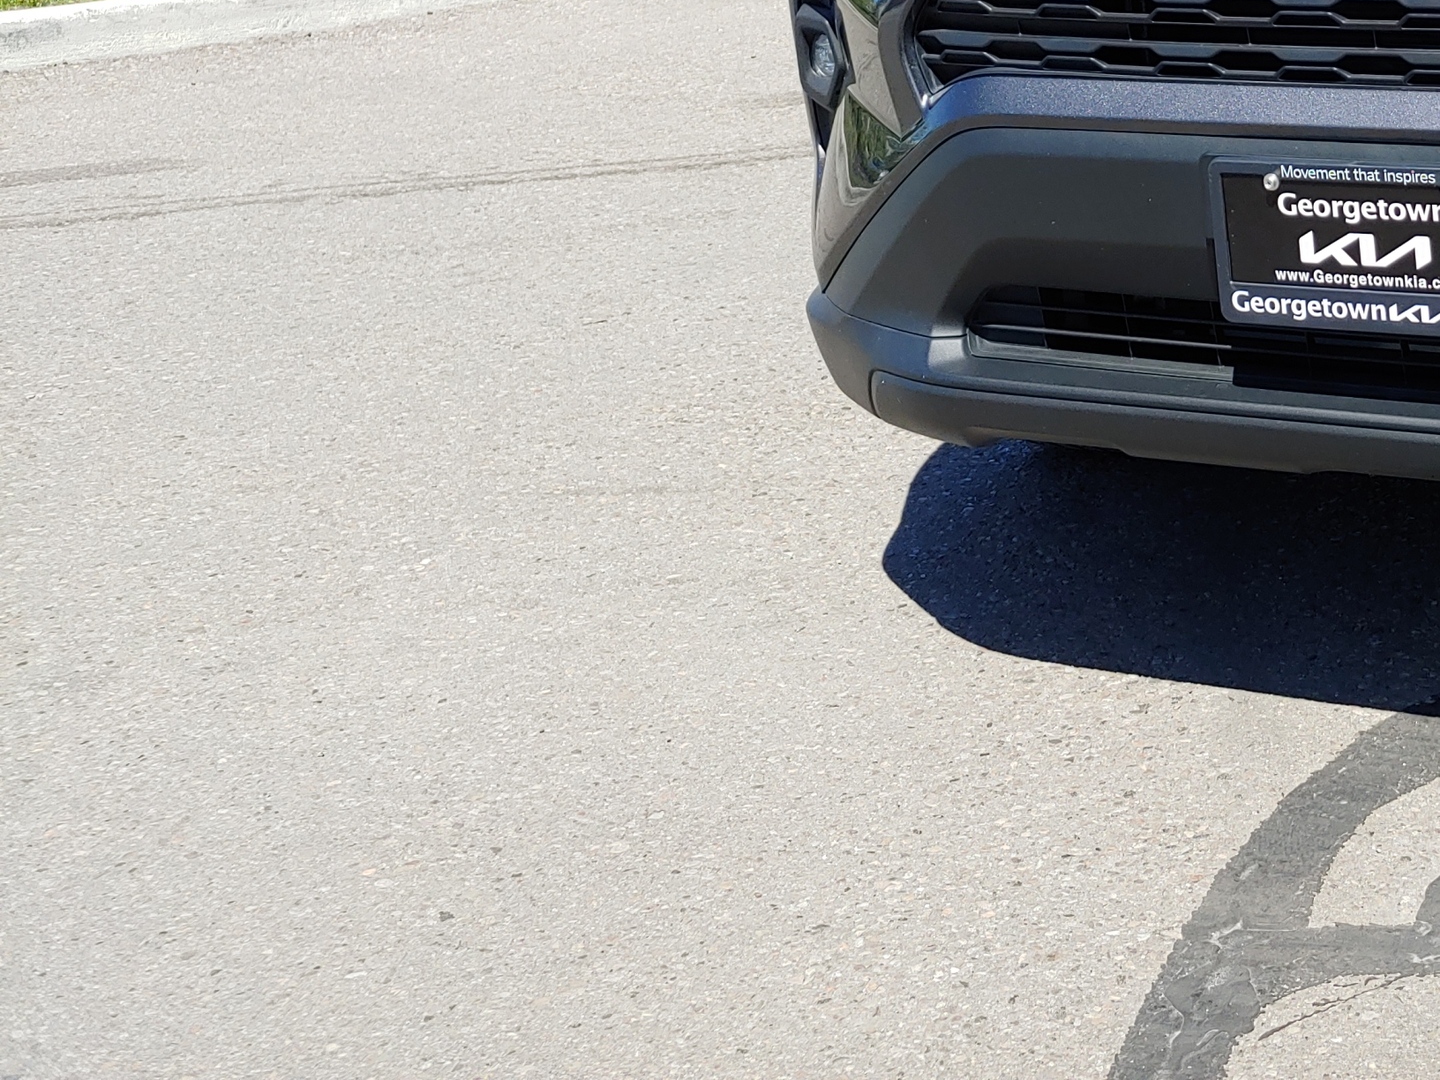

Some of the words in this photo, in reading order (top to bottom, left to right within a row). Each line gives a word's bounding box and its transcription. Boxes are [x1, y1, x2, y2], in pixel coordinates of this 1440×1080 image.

[1280, 164, 1350, 180] Movement
[1353, 168, 1381, 182] that
[1383, 169, 1436, 185] inspires
[1298, 230, 1432, 270] KIA
